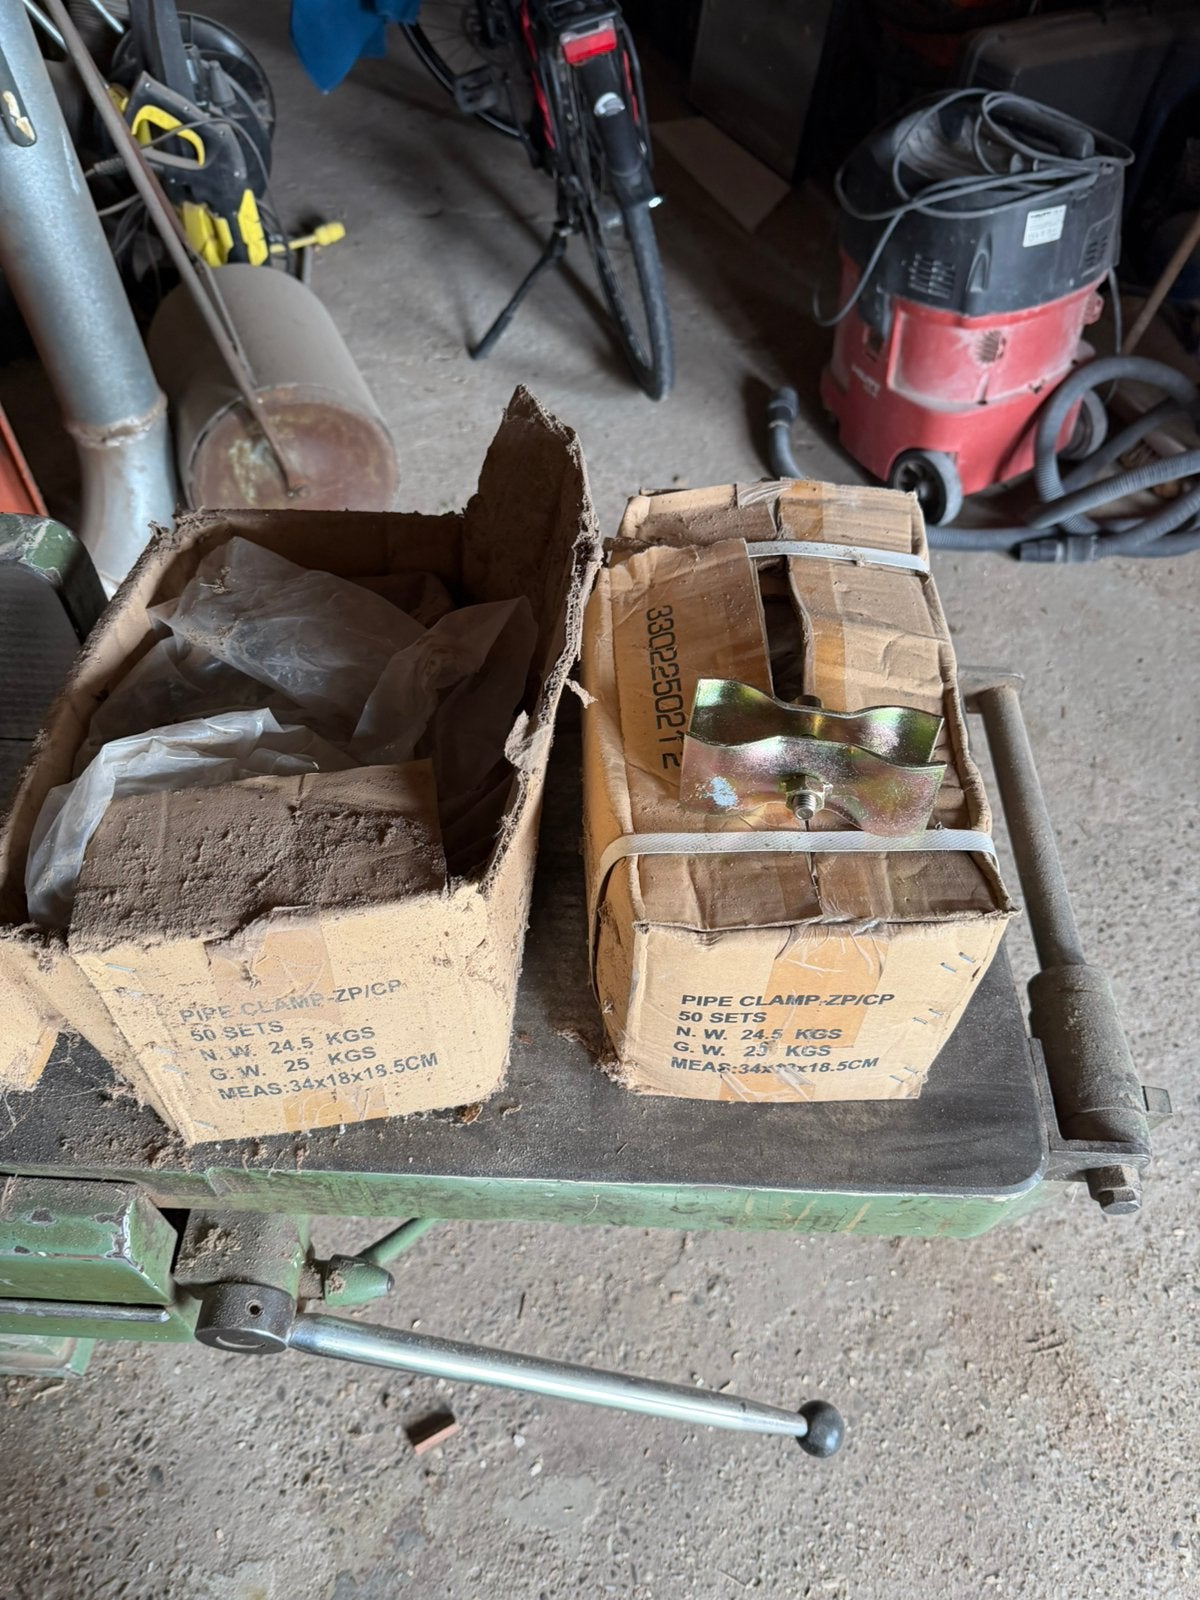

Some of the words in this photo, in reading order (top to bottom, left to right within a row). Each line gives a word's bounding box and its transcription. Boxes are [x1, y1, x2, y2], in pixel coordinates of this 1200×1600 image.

[681, 994, 733, 1007] PIPE
[180, 1005, 234, 1022] PIPE
[678, 1011, 702, 1023] 50
[709, 1011, 767, 1023] SETS
[191, 1028, 216, 1041] 50
[222, 1020, 284, 1040] SETS
[676, 1026, 696, 1038] N.
[704, 1029, 728, 1040] W.
[741, 1029, 783, 1040] 24.5
[795, 1029, 842, 1040] KGS
[268, 1036, 314, 1055] 24.5
[326, 1026, 376, 1046] KGS
[673, 1041, 694, 1053] G.
[702, 1045, 726, 1056] W.
[743, 1041, 768, 1057] 25
[785, 1045, 831, 1057] KGS
[283, 1058, 310, 1072] 25
[328, 1046, 377, 1066] KGS
